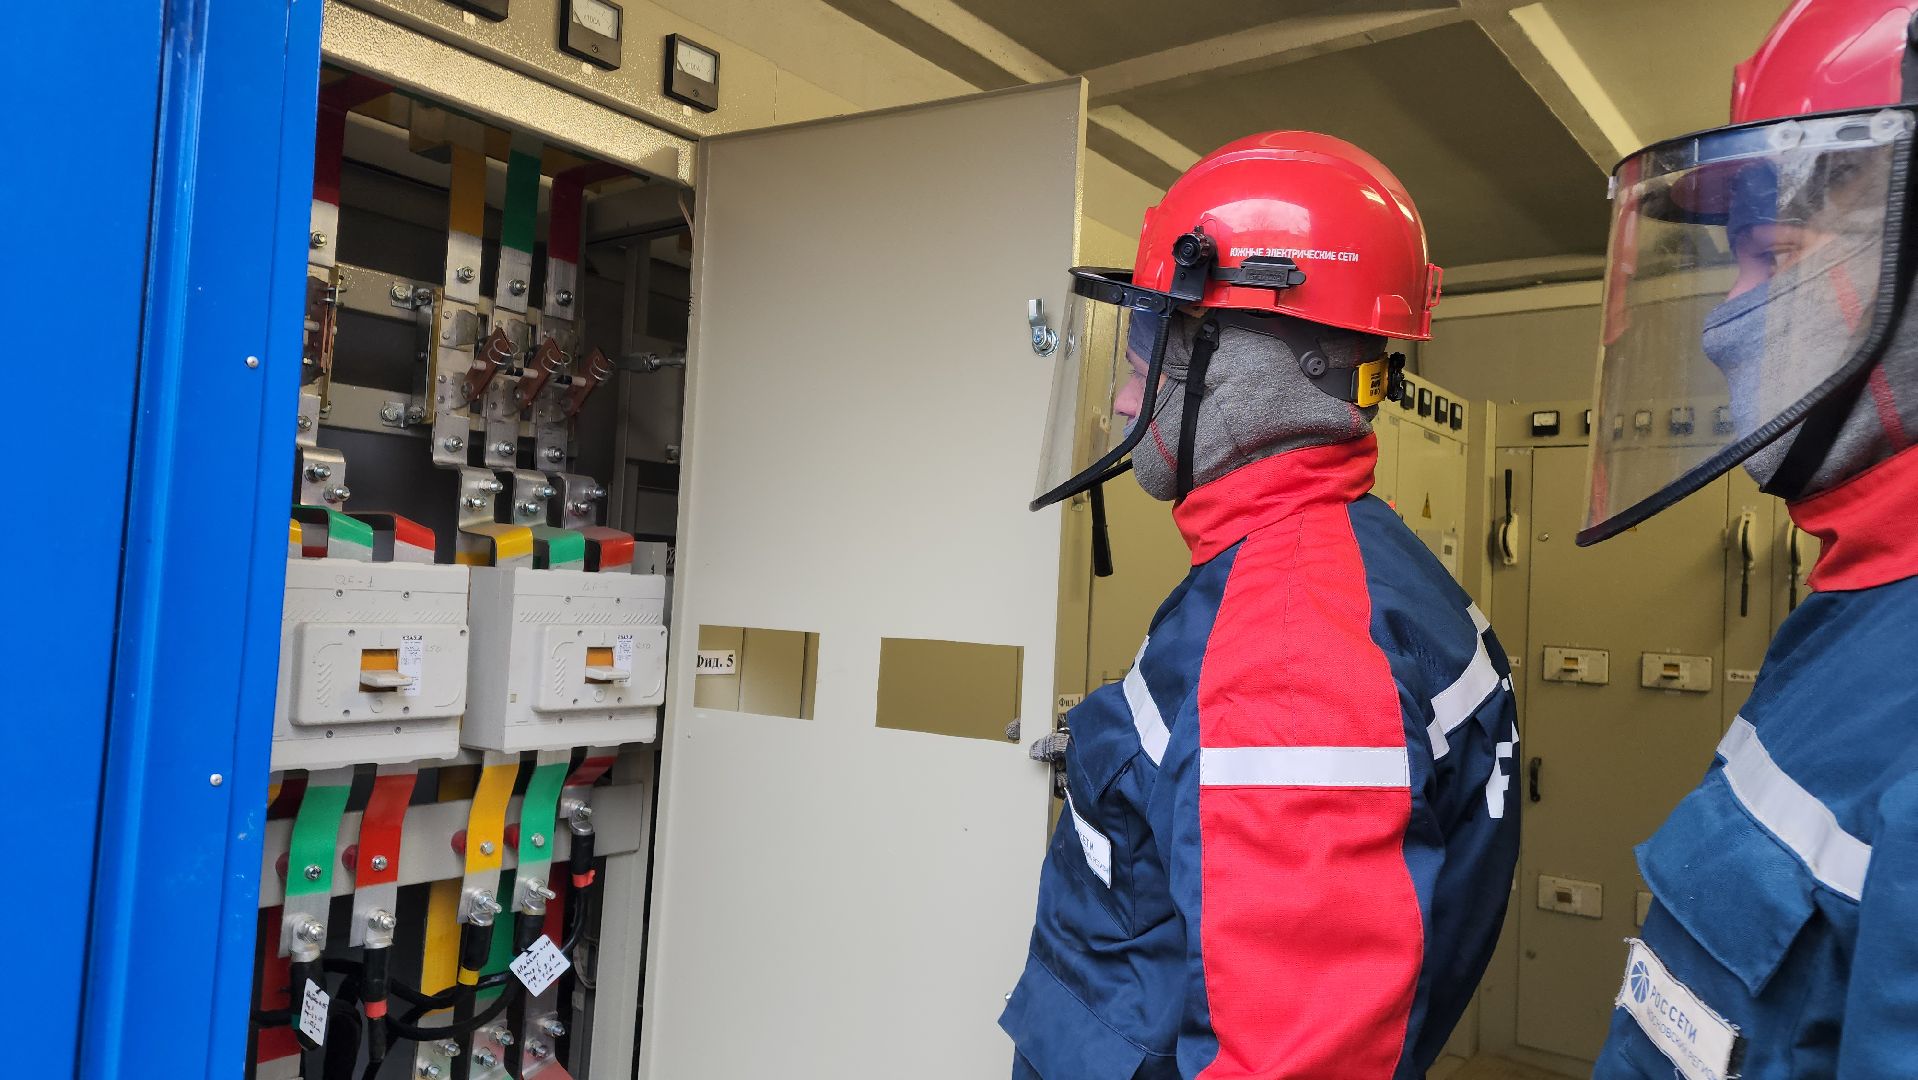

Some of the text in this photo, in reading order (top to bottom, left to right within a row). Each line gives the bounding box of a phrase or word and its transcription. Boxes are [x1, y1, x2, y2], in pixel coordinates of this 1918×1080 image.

[1230, 247, 1359, 262] ЮЖНЫЕ ЭЛЕКТРИЧЕСКИЕ СЕТИ
[726, 654, 734, 667] 5
[1650, 985, 1697, 1044] РОССЕТИ
